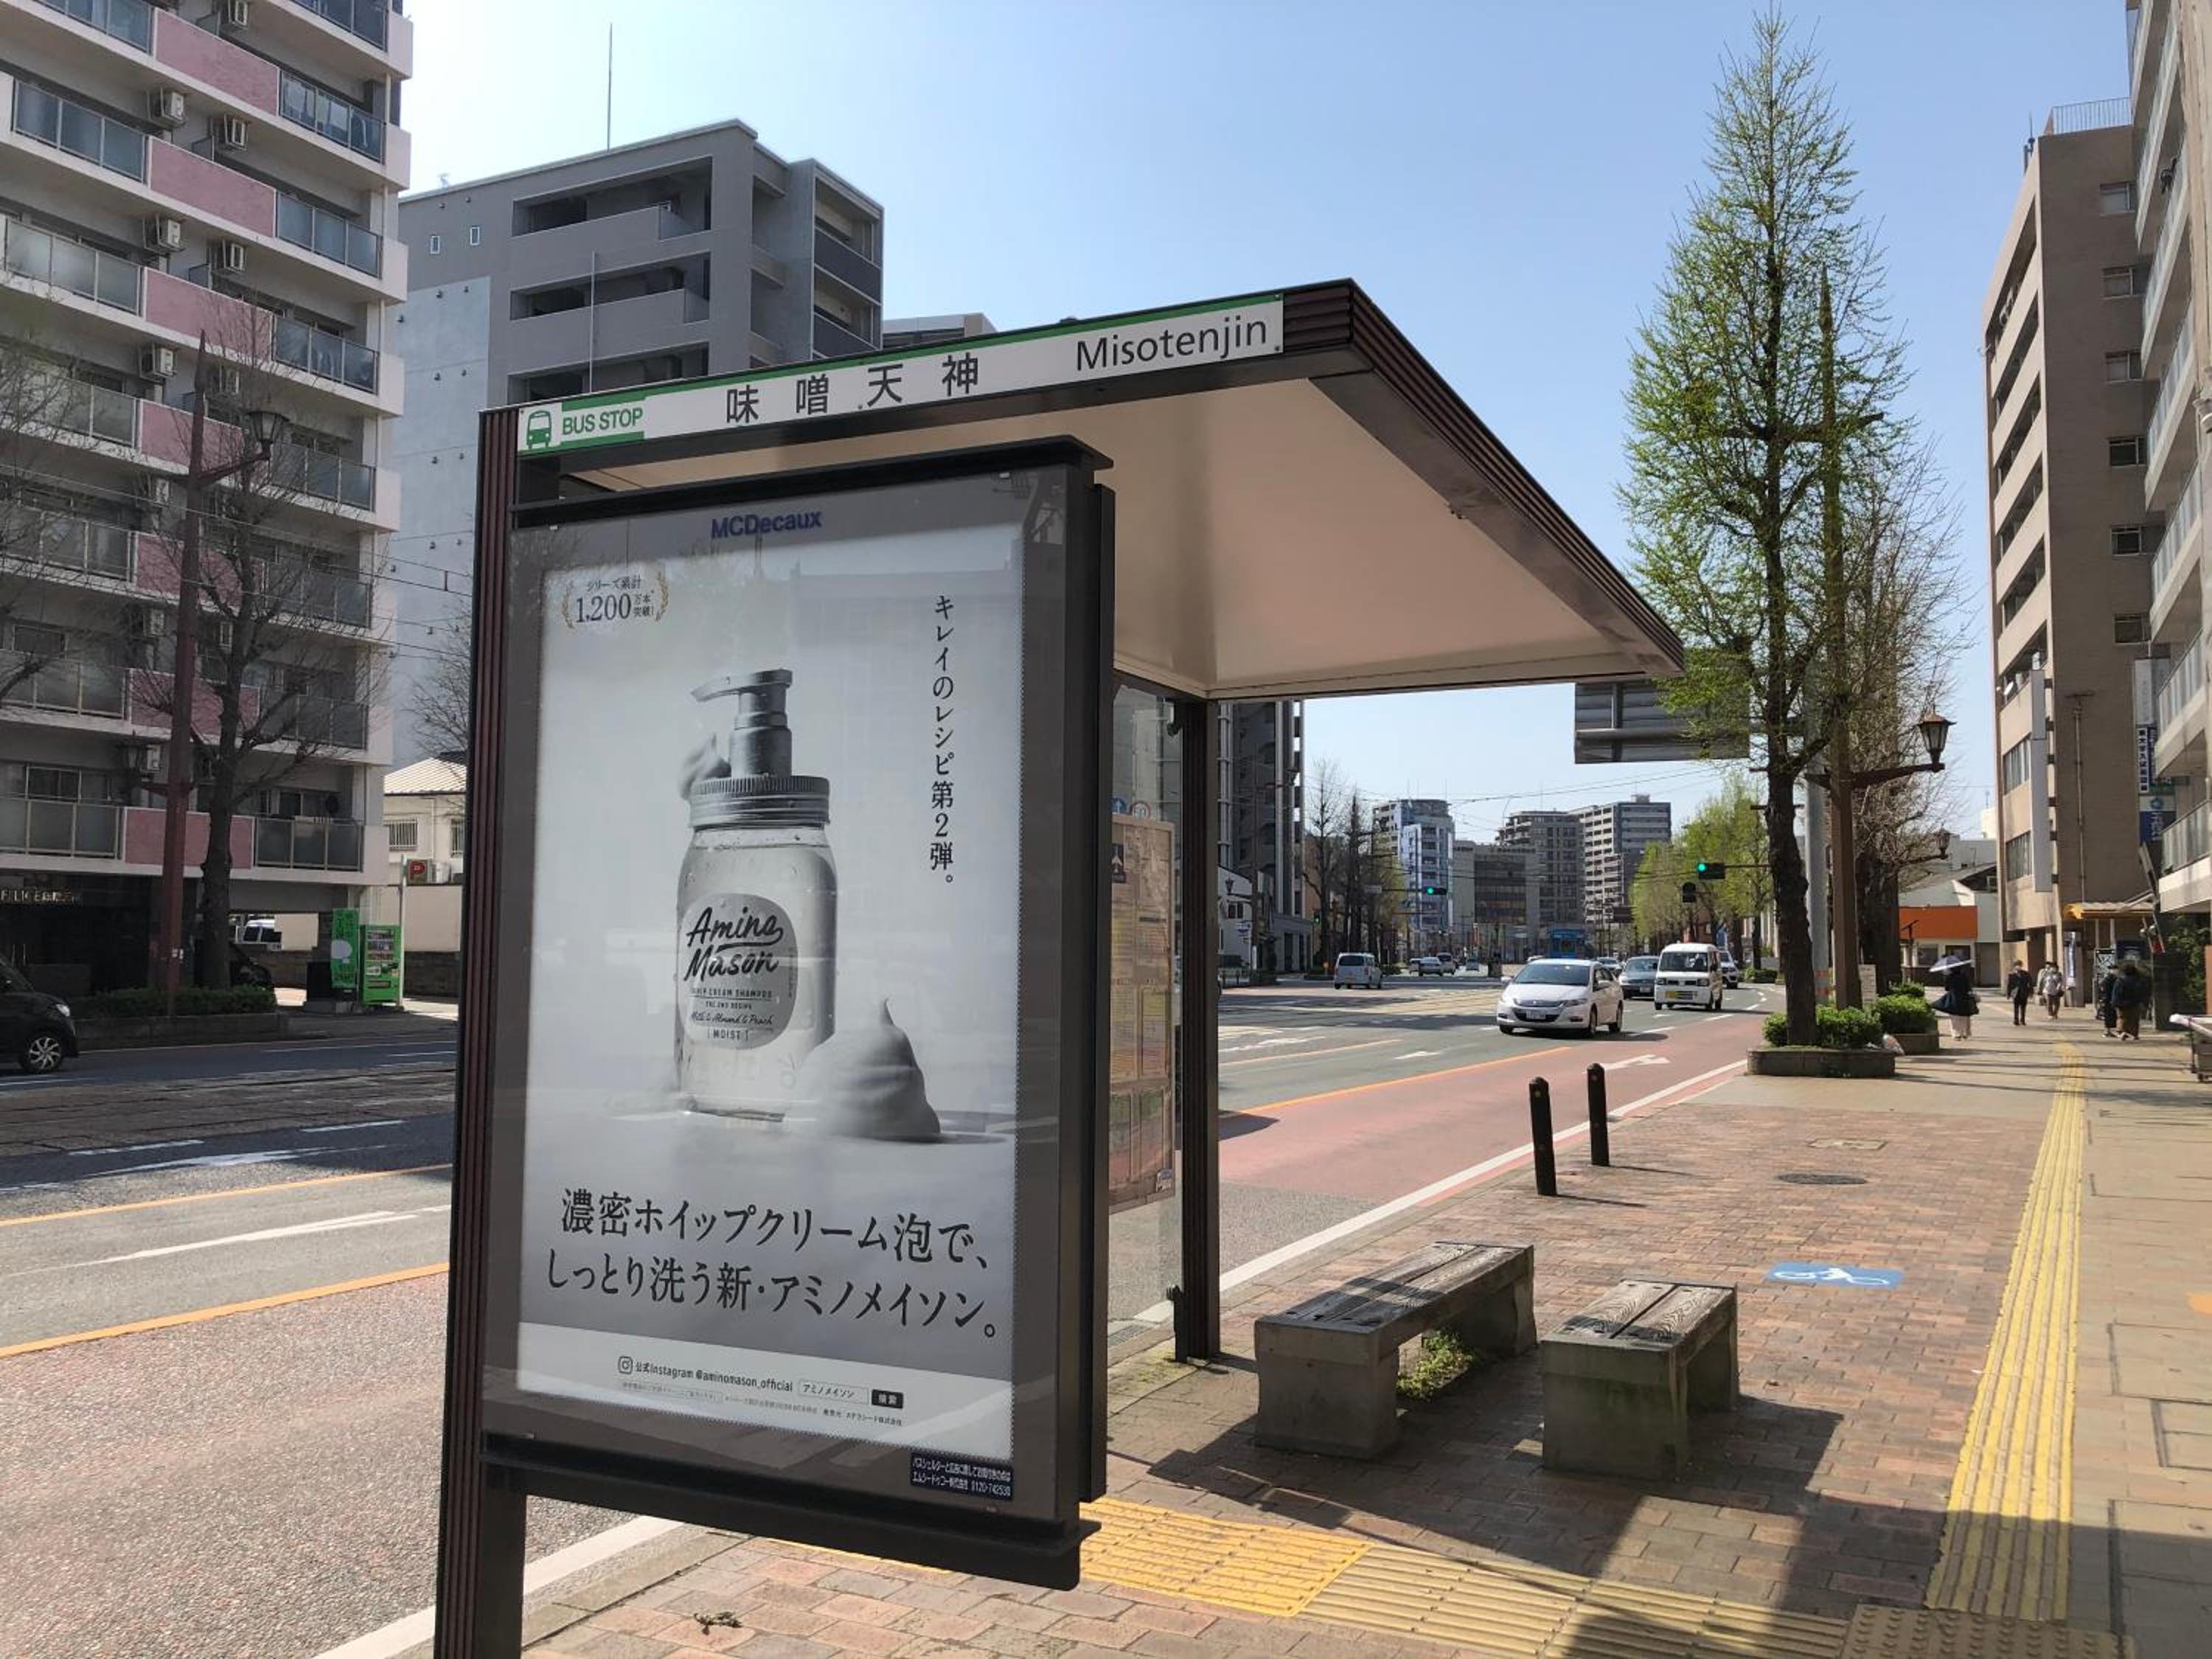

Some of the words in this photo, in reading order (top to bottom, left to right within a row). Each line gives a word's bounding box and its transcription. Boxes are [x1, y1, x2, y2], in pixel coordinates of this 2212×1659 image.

[1077, 315, 1267, 371] Misotenjin
[726, 352, 978, 423] 味噌天神
[563, 415, 595, 435] BUS
[599, 408, 643, 430] STOP
[712, 511, 822, 539] MCDecaux
[576, 592, 632, 623] 1,200
[929, 595, 955, 883] キレイのレシピ第2弾。
[684, 945, 779, 982] Mason
[562, 1188, 988, 1268] 濃密ホイップクリーム泡で、
